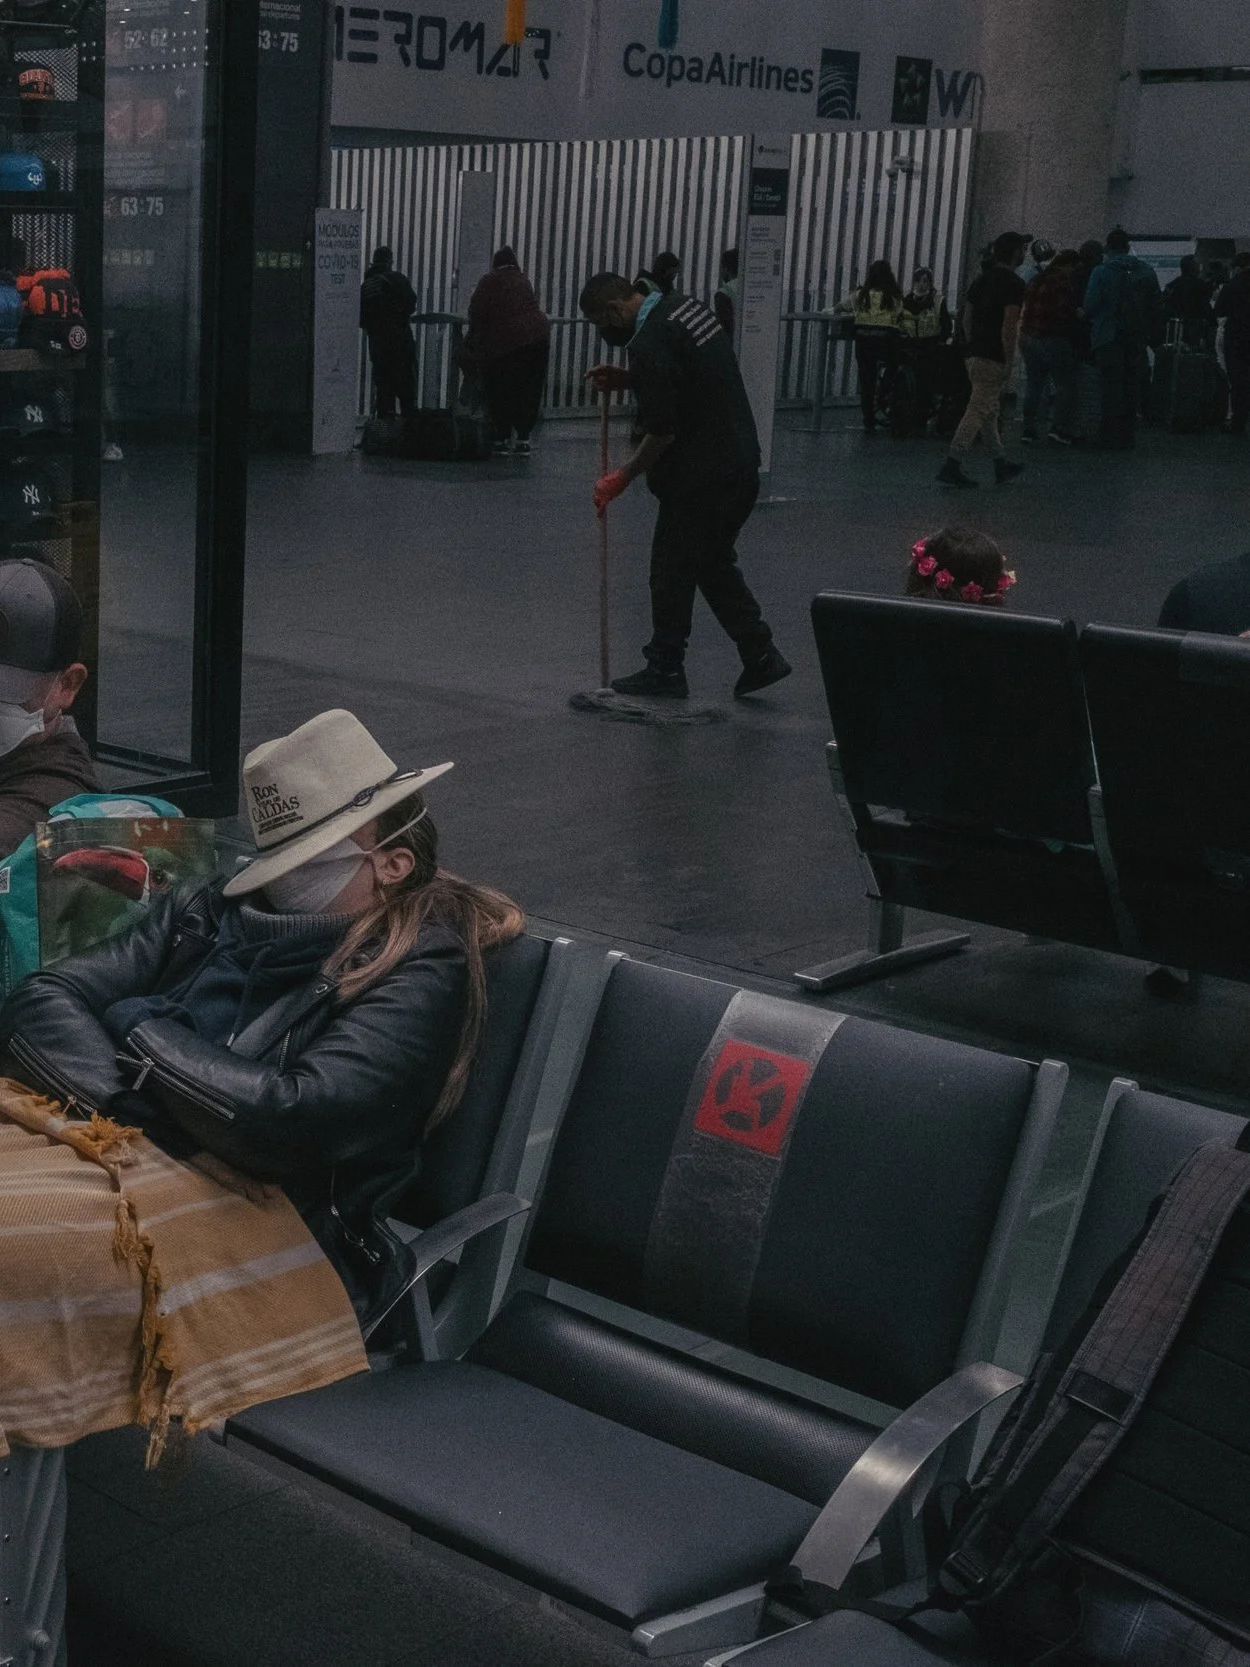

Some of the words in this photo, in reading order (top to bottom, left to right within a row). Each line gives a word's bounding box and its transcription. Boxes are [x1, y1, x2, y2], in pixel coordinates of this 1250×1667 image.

[24, 404, 44, 423] NY
[22, 484, 41, 504] NY
[251, 784, 278, 800] RON
[252, 796, 300, 822] CALDAS
